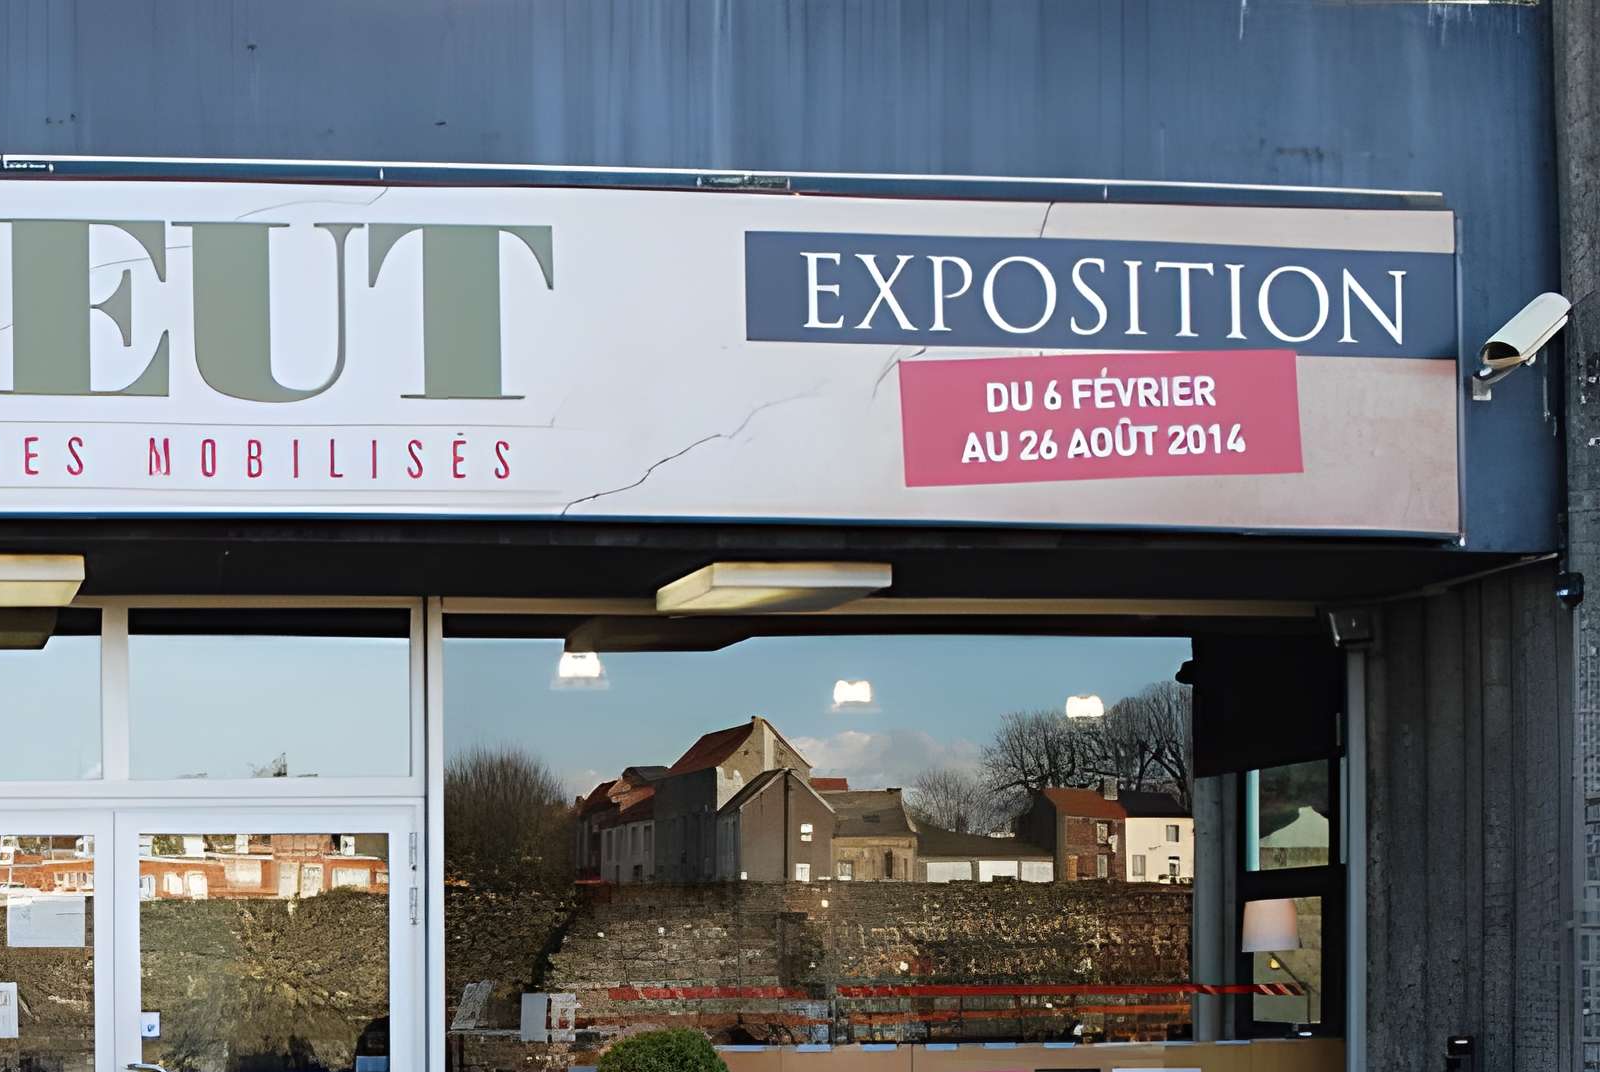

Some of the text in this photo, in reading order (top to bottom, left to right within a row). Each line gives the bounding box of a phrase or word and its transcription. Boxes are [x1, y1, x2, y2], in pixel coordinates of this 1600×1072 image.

[800, 251, 1407, 346] EXPOSITION
[986, 367, 1217, 414] DU 6 FÉVRIER
[961, 417, 1247, 464] AU 26 AOÛT 2014
